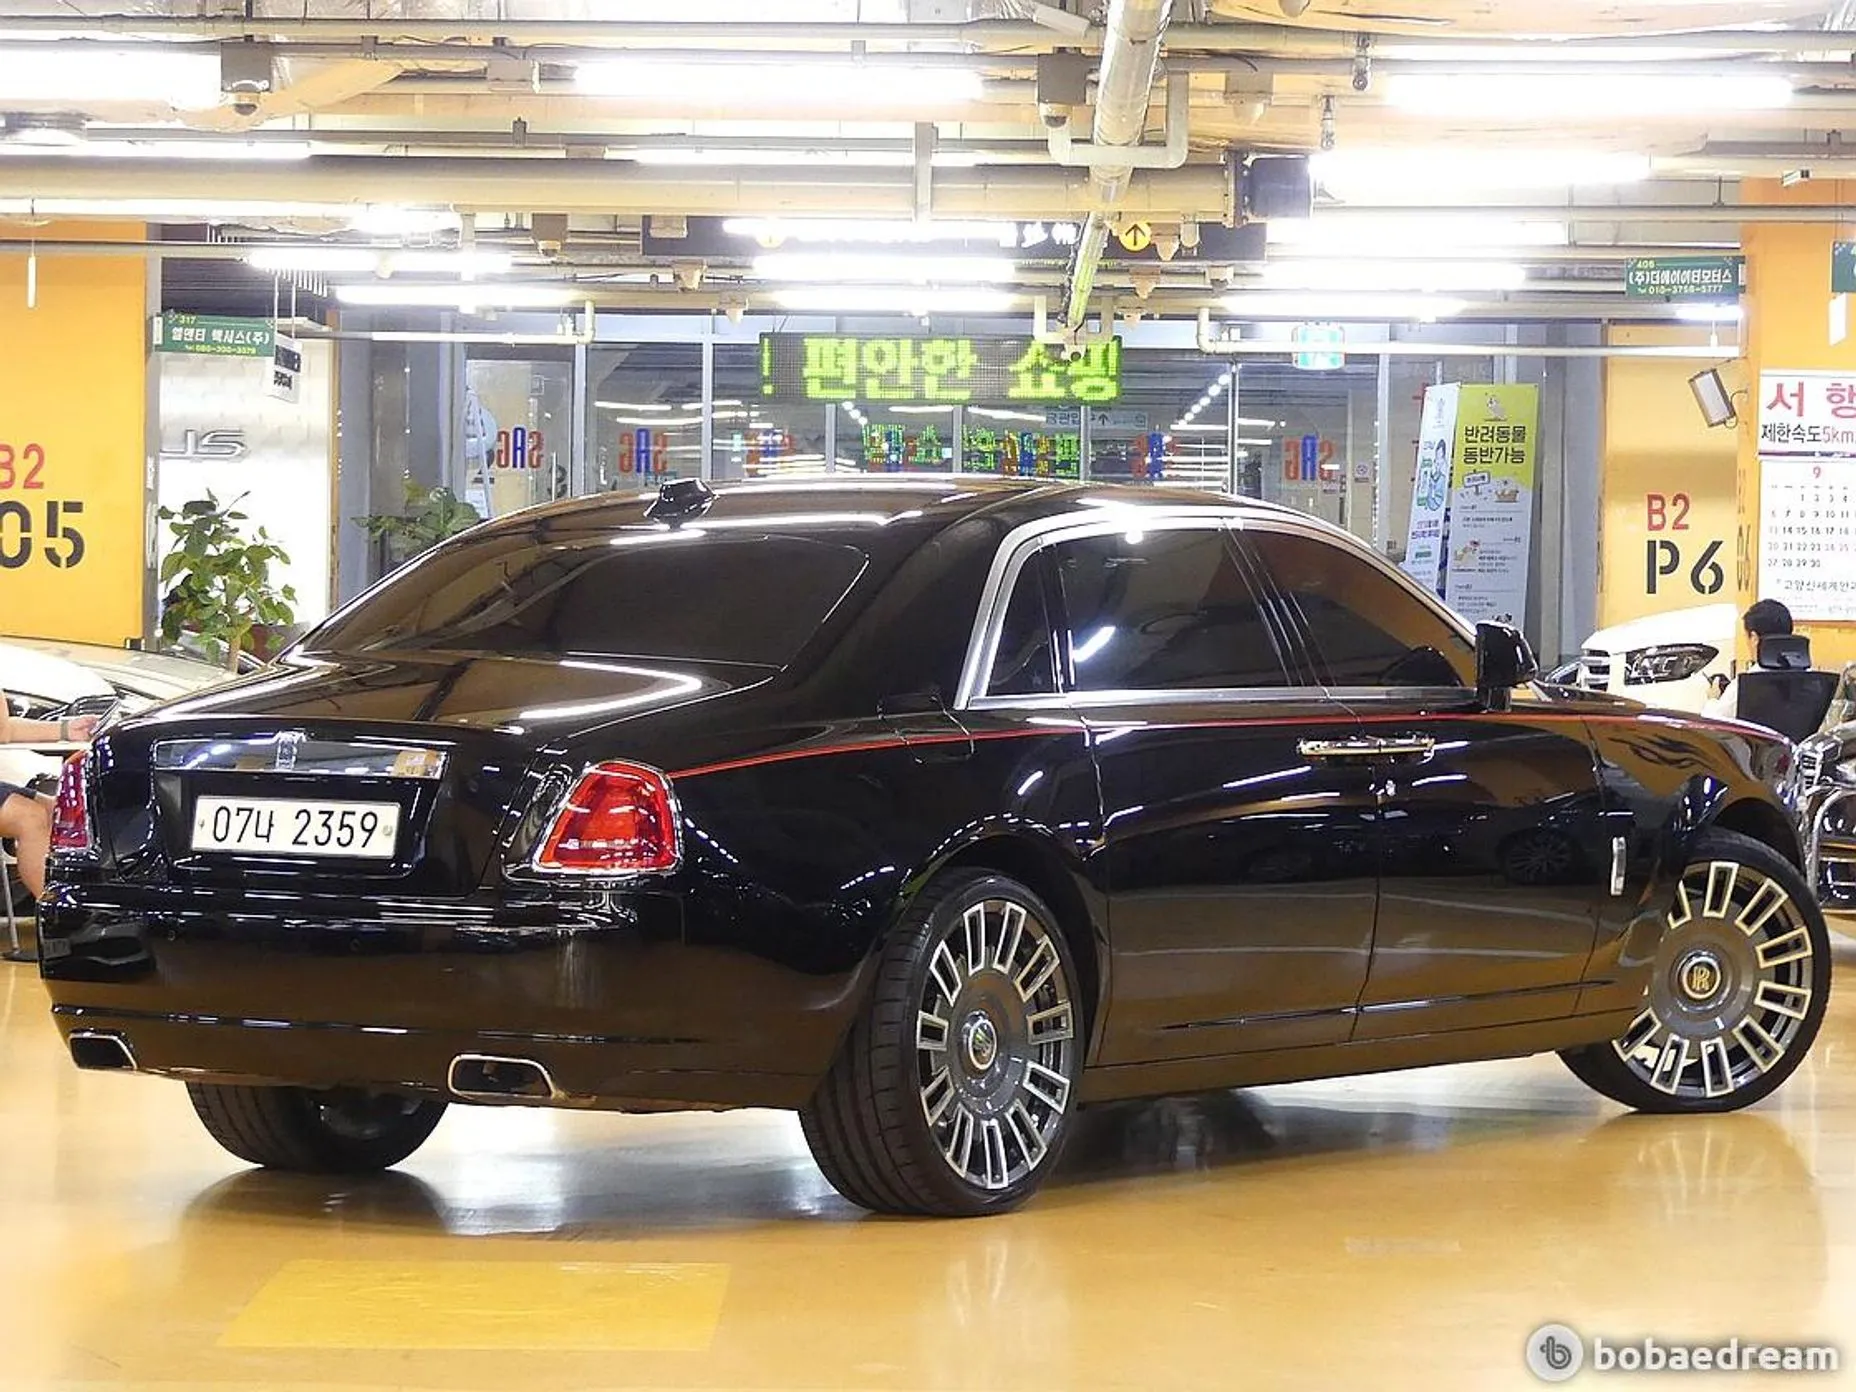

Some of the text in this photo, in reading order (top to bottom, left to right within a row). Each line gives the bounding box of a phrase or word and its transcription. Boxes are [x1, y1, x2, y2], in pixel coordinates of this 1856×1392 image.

[802, 337, 979, 400] 편안한
[1007, 337, 1118, 400] 쇼핑
[1464, 425, 1526, 443] 반려동물
[1463, 447, 1525, 465] 동반가능
[1813, 466, 1821, 479] 9
[1646, 493, 1690, 531] B2
[1826, 510, 1836, 518] 10
[1841, 510, 1849, 518] 11
[0, 500, 85, 569] 05
[1646, 539, 1680, 594] P
[1690, 539, 1724, 595] 6
[292, 809, 378, 848] 2359
